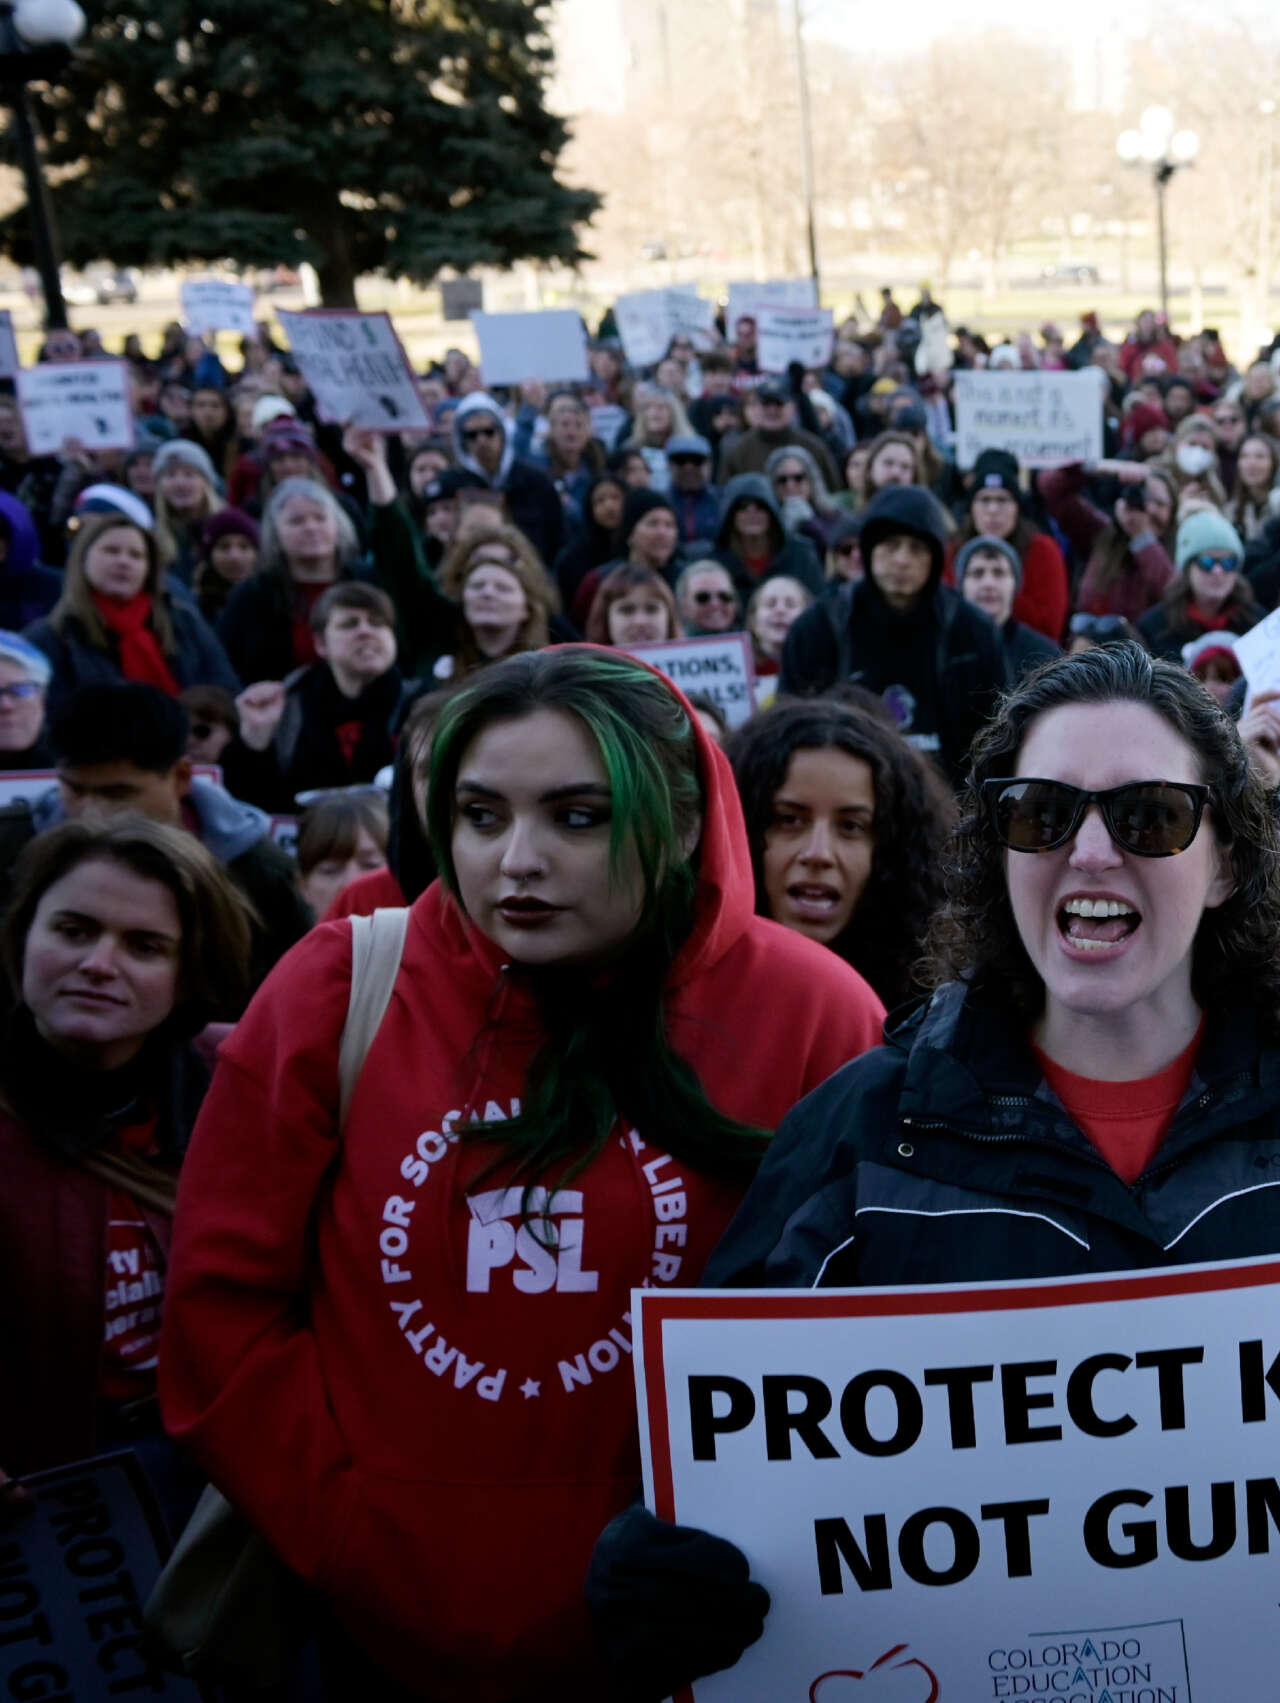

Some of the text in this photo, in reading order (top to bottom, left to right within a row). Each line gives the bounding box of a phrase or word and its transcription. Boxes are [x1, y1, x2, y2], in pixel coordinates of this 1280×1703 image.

[379, 1195, 416, 1283] FOR
[466, 1216, 599, 1295] PSL
[557, 1153, 688, 1393] LIBERION
[389, 1299, 508, 1402] PARTY
[688, 1345, 1204, 1462] PROTECT
[38, 1478, 165, 1697] PROTECT
[814, 1498, 1050, 1596] NOT
[988, 1636, 1142, 1673] COLORADO
[992, 1663, 1153, 1698] EDUCATION
